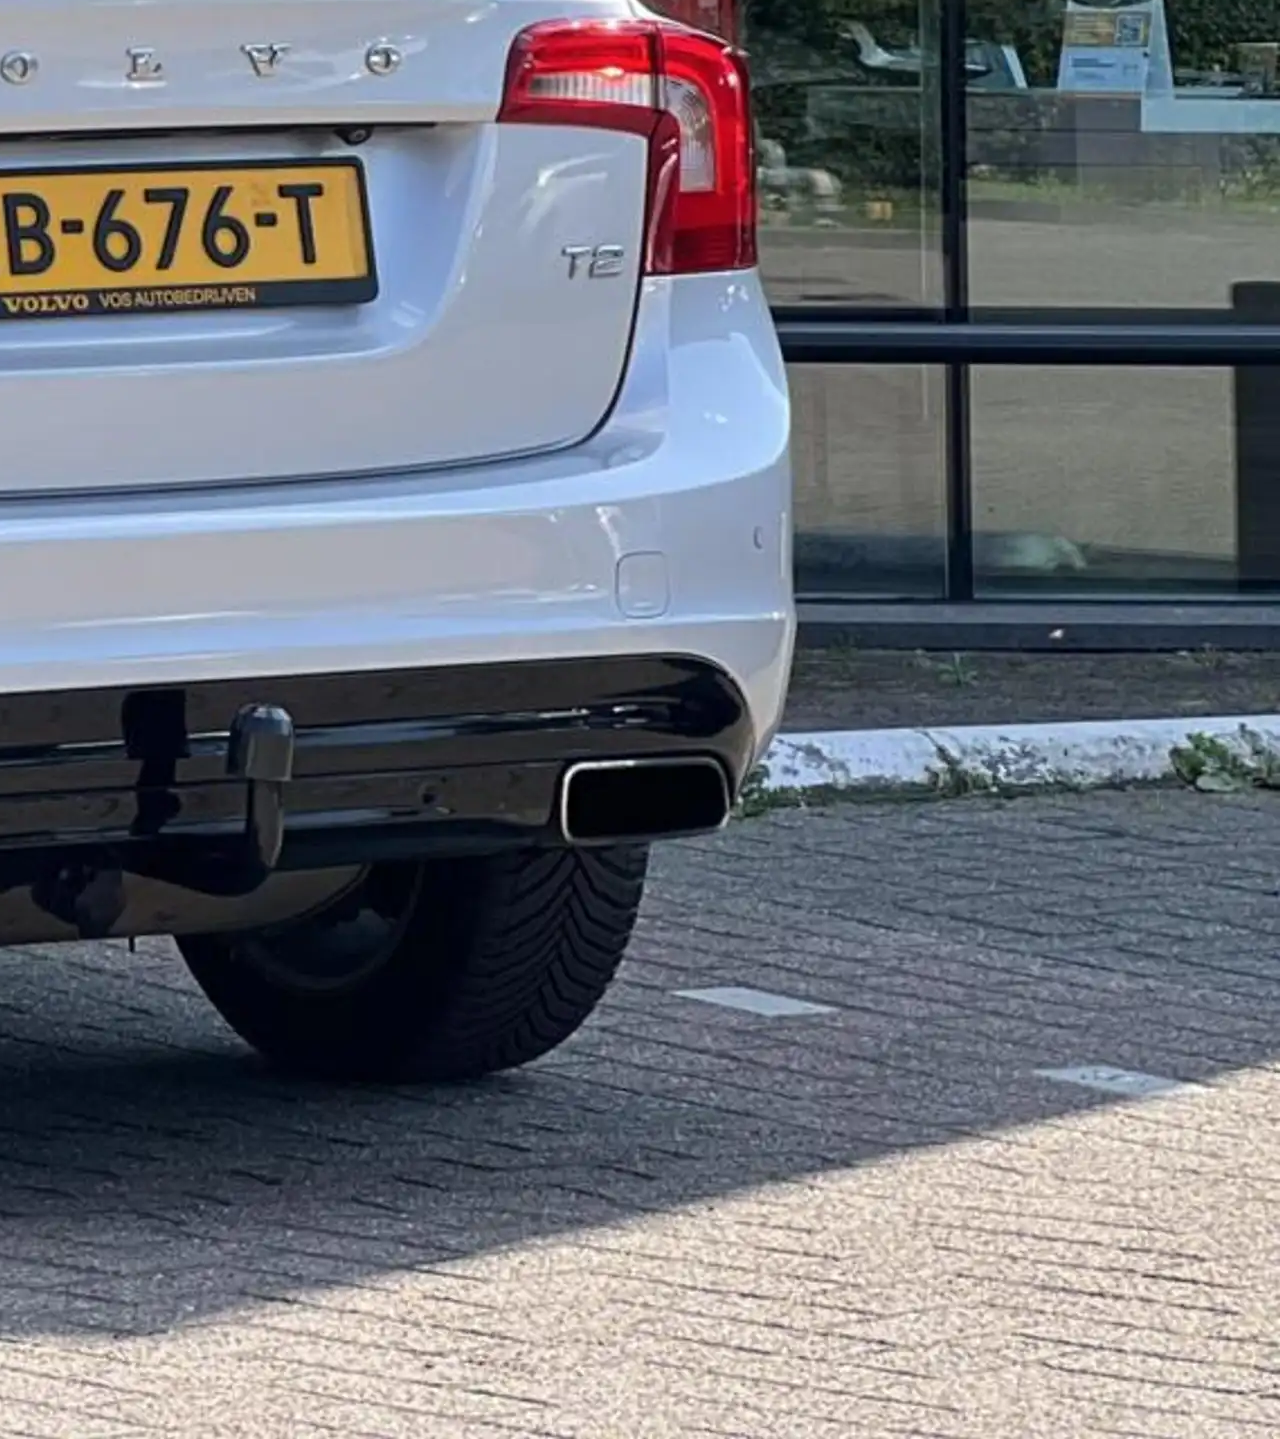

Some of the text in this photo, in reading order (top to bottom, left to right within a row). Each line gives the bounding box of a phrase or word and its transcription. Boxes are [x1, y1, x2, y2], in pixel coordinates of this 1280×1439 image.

[1, 287, 257, 314] VOLVO VOS AUTOBEDRIJVEN
